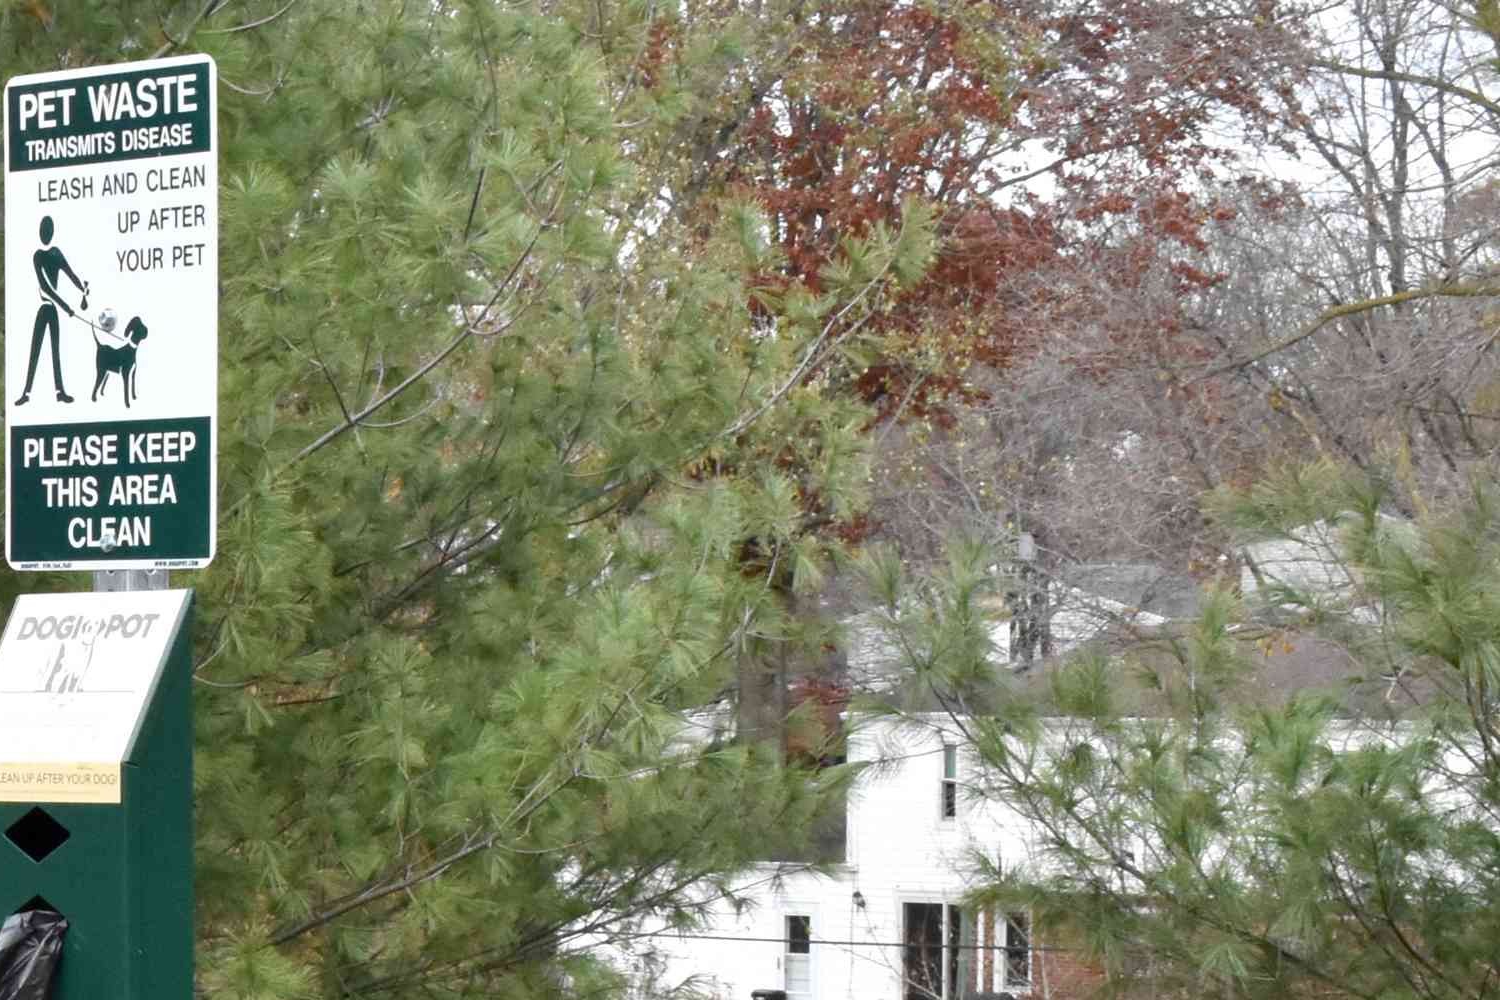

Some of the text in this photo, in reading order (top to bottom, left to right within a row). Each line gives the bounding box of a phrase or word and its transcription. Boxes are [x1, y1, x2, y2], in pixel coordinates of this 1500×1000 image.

[19, 74, 198, 131] PET WASTE
[25, 123, 193, 162] TRANSMITS DISEASE
[38, 165, 206, 202] LEASH AND CLEAN
[118, 205, 205, 233] UP AFTER
[116, 244, 205, 272] YOUR PET
[23, 431, 196, 468] PLEASE KEEP
[41, 474, 177, 508] THIS AREA
[67, 516, 151, 548] CLEAN
[22, 772, 35, 784] UP
[36, 772, 64, 785] AFTER
[67, 773, 92, 785] YOUR
